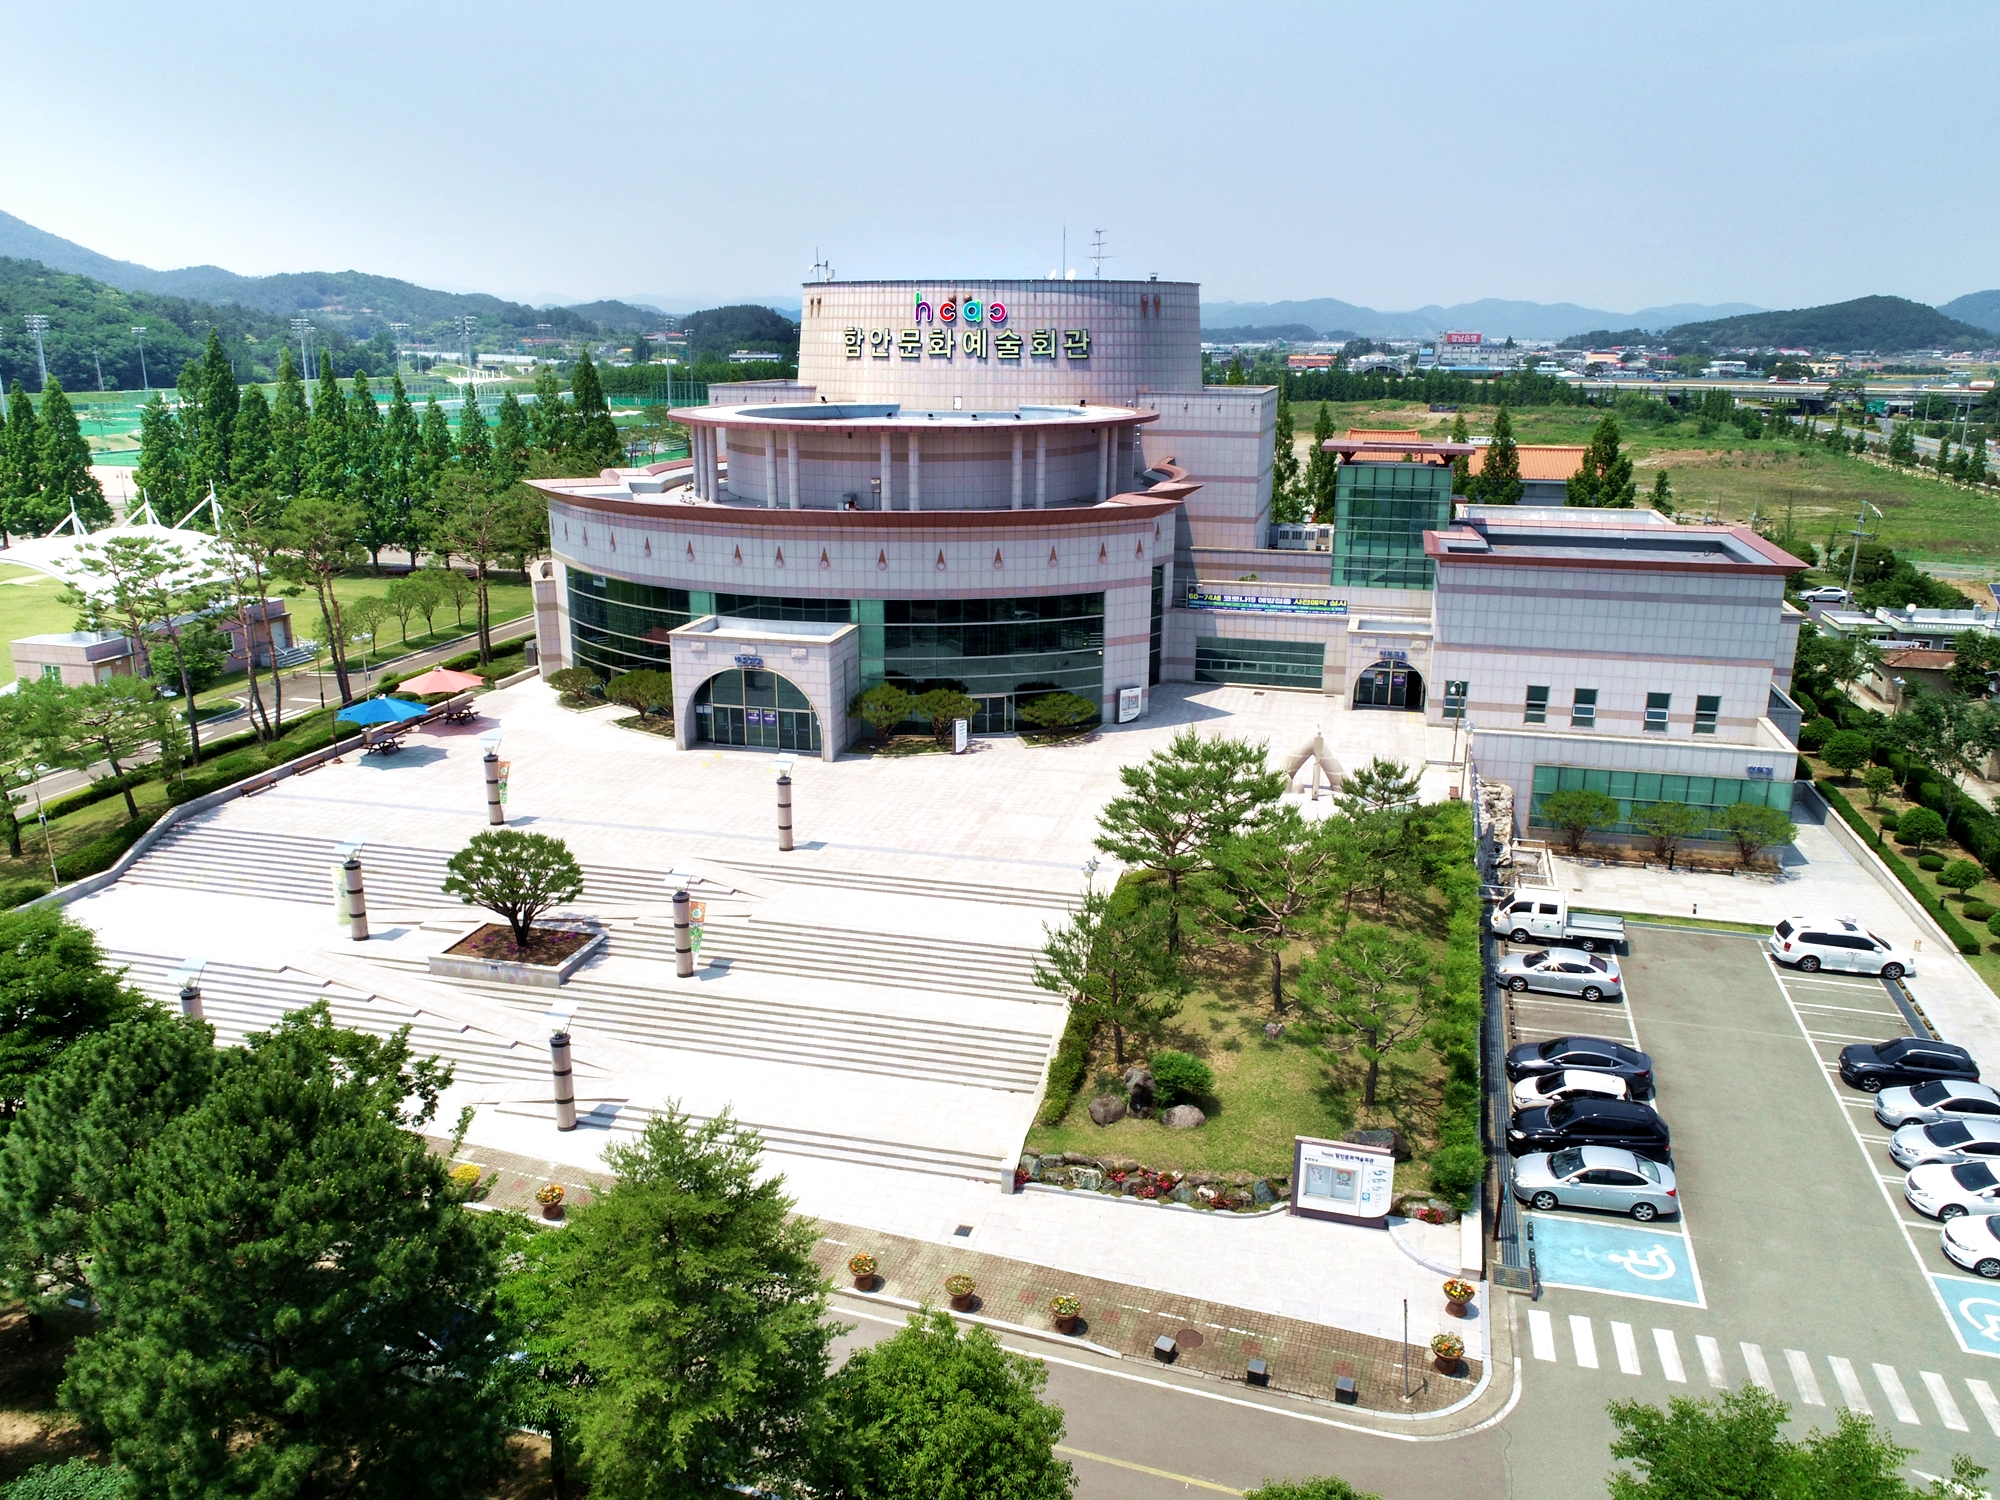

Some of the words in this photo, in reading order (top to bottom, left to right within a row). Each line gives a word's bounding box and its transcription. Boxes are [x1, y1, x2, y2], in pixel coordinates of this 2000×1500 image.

[843, 327, 1092, 359] 함안문화예술회관
[1451, 334, 1478, 343] 경남은행
[1189, 593, 1221, 601] 60~74세
[1223, 595, 1256, 603] 코로나19
